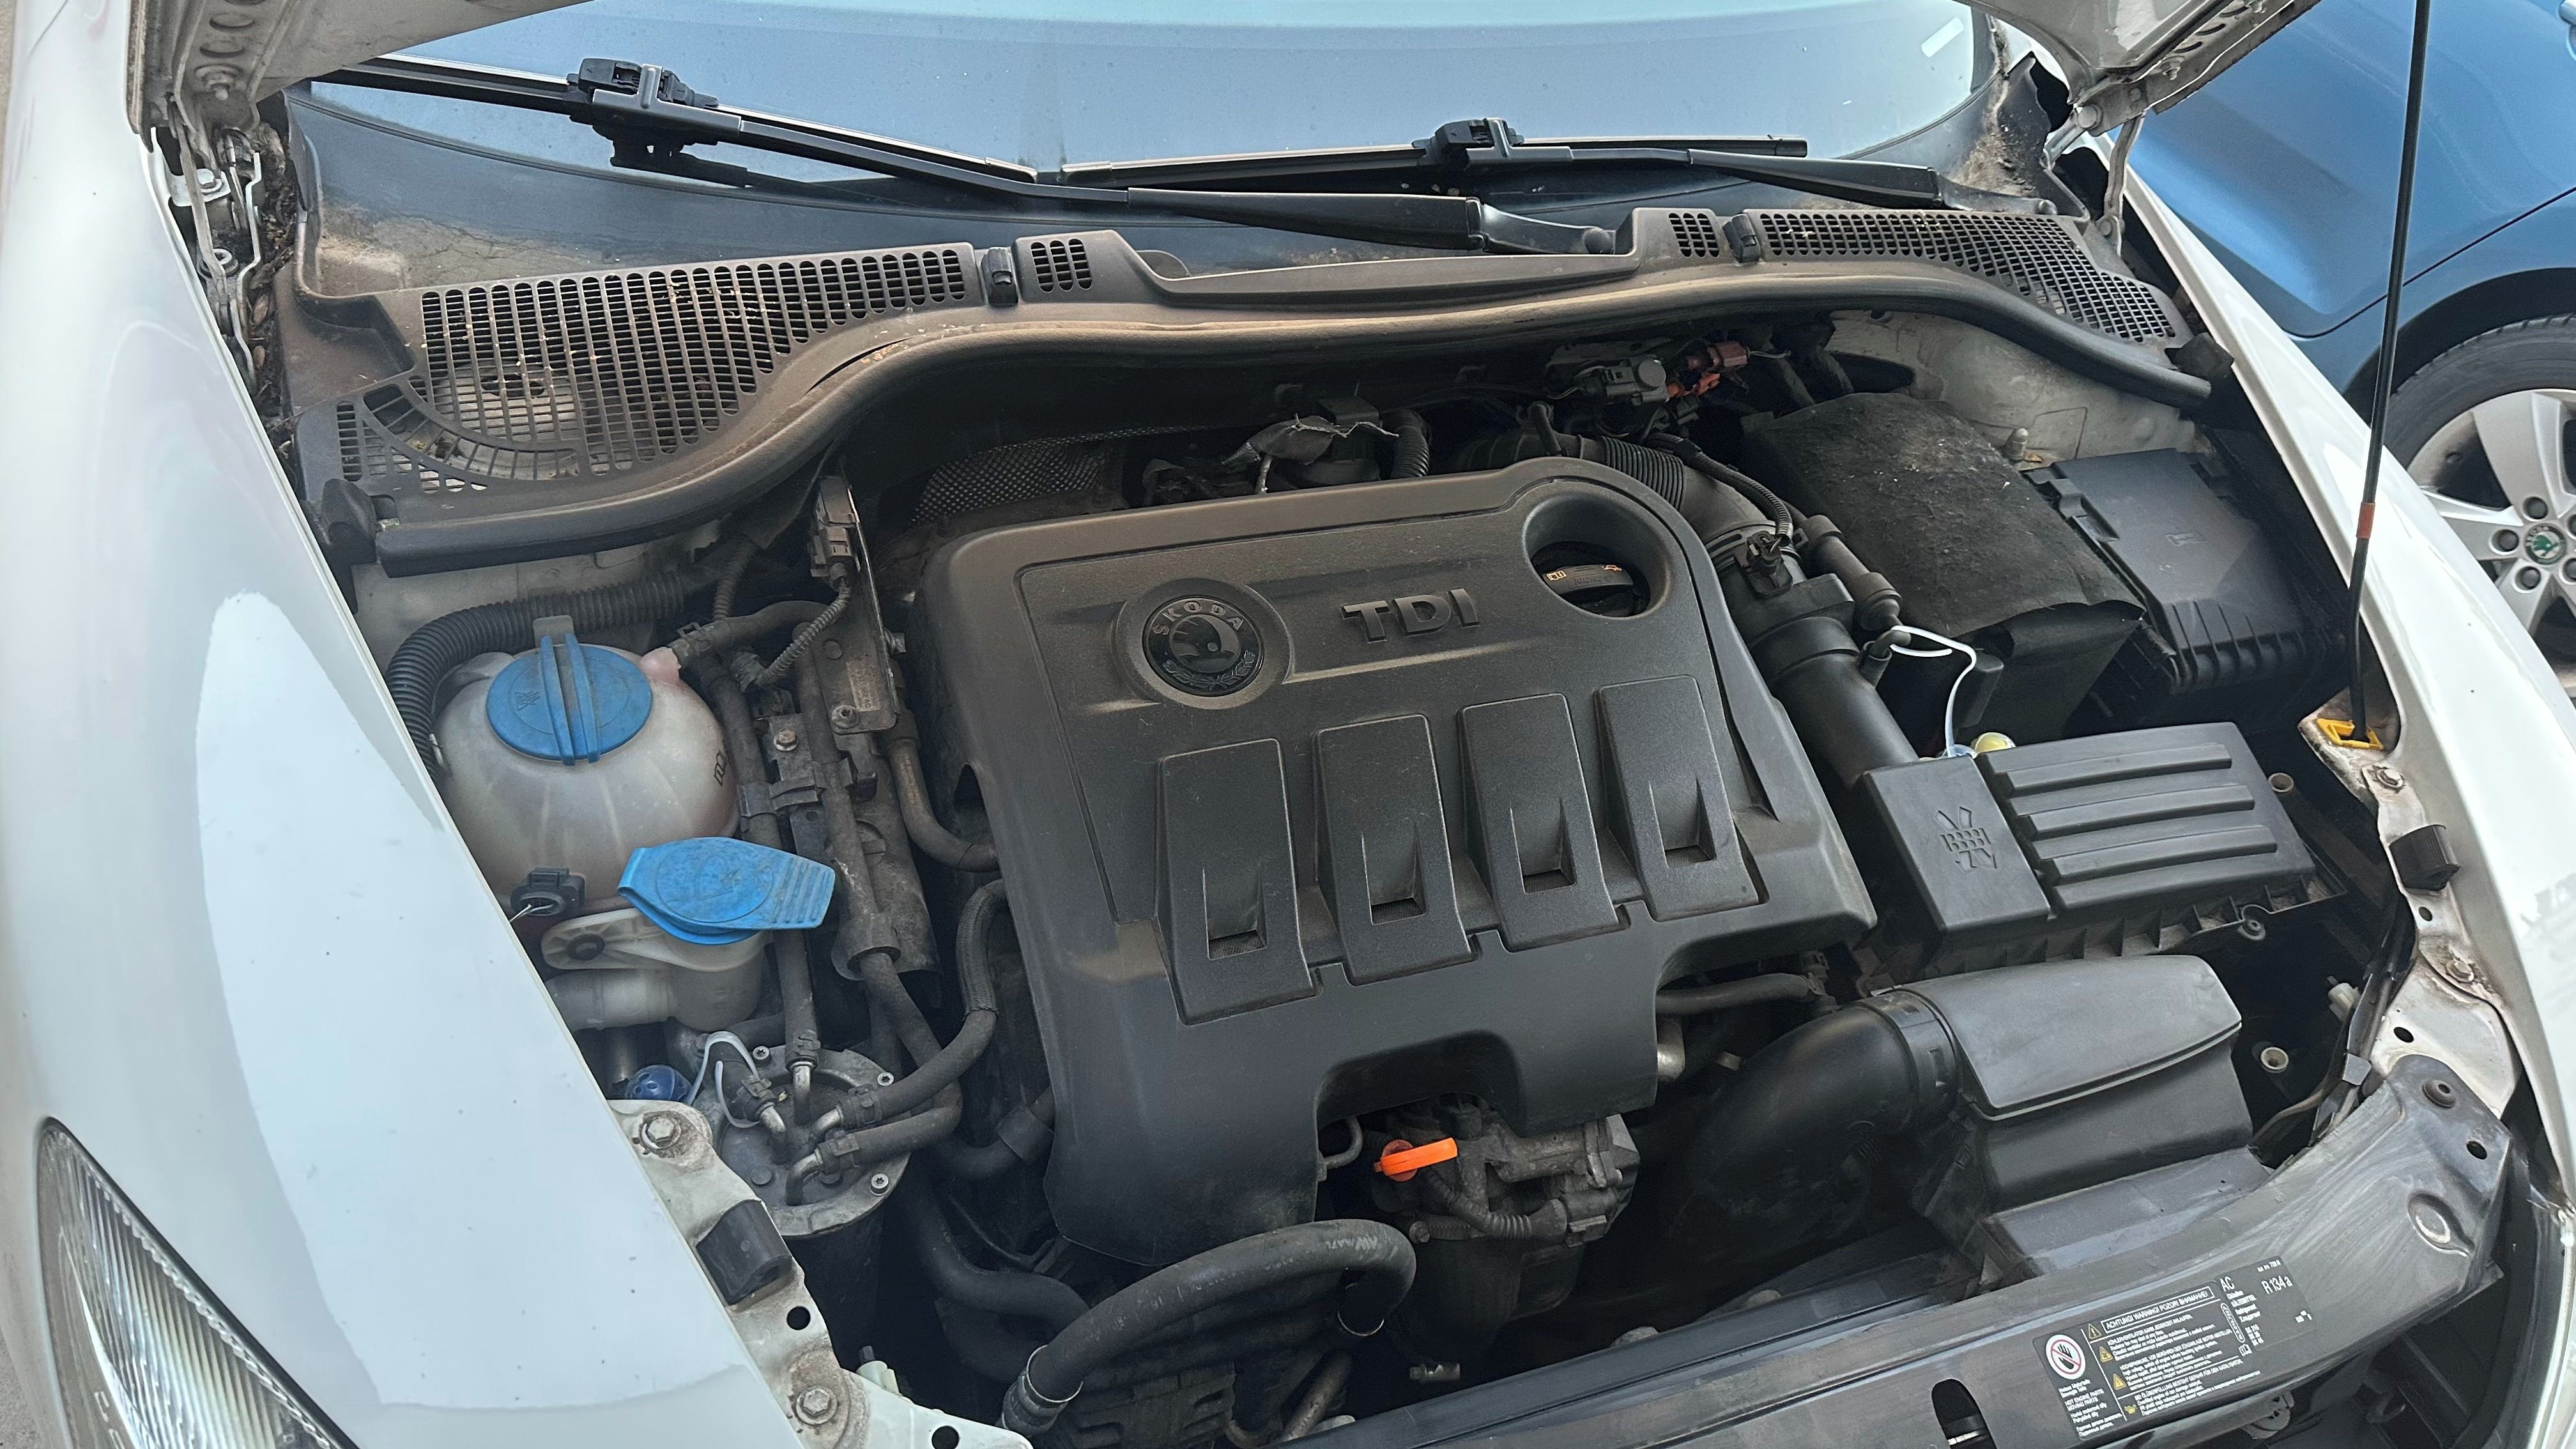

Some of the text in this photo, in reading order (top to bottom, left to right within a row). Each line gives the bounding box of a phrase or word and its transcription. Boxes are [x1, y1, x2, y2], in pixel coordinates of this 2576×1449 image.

[1341, 588, 1481, 643] TDI
[2220, 1276, 2235, 1291] AC
[2106, 1315, 2134, 1329] ACHTUNG!
[2133, 1306, 2159, 1319] WARNING!
[2159, 1300, 2179, 1311] POZOR!
